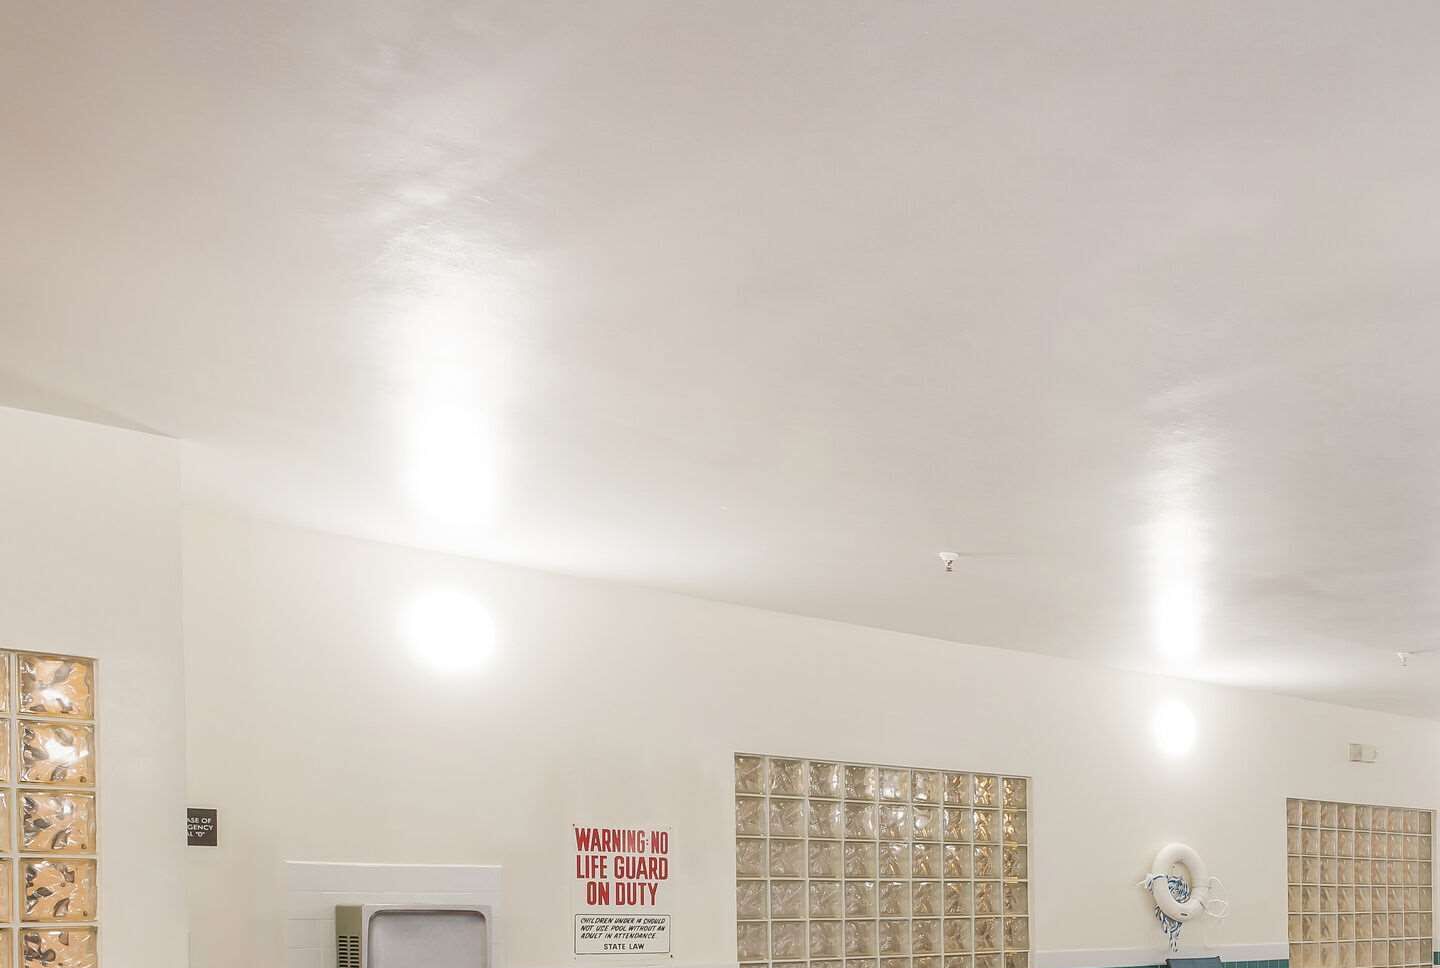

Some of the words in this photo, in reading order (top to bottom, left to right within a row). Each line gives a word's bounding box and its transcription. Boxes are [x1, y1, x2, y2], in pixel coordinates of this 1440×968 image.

[651, 831, 668, 854] NO
[576, 855, 608, 879] LIFE
[614, 855, 668, 880] GUARD
[586, 881, 610, 905] ON
[615, 882, 658, 906] DUTY
